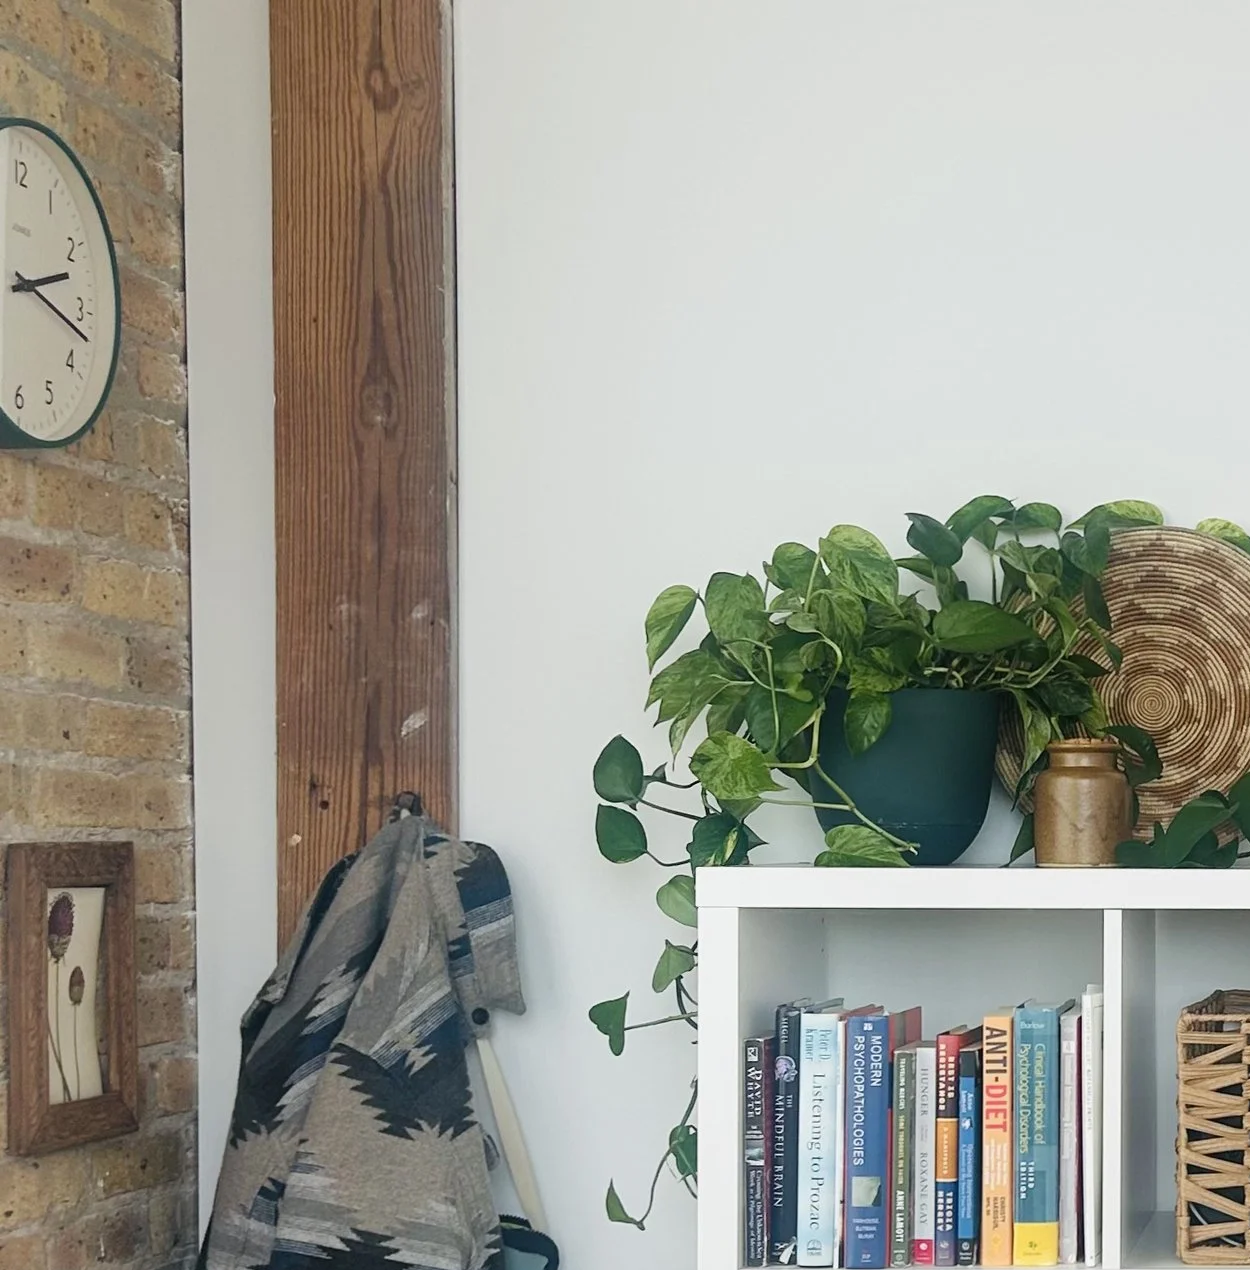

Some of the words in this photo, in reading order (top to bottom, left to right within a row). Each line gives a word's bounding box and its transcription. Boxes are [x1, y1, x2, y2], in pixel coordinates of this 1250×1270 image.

[14, 158, 28, 189] 12
[67, 237, 76, 263] 2
[76, 297, 86, 323] 3
[65, 349, 75, 374] 4
[14, 385, 25, 411] 6
[45, 381, 54, 405] 5
[805, 1029, 816, 1060] Kramer
[818, 1030, 832, 1051] Peter
[870, 1036, 882, 1086] MODERN
[985, 1026, 1007, 1132] ANTI-DIET
[1017, 1044, 1030, 1107] Psychological
[1034, 1044, 1046, 1077] Clinical
[747, 1067, 755, 1118] WHYTE
[754, 1070, 762, 1115] DAVID
[853, 1035, 865, 1165] PSYCHOPATHOLOGIES
[920, 1068, 929, 1116] HUNGER
[1034, 1080, 1046, 1132] Handbook
[774, 1095, 785, 1158] MINDFUL
[808, 1074, 825, 1150] Listening
[1019, 1109, 1029, 1153] Disorders
[1034, 1134, 1046, 1144] of
[811, 1156, 824, 1172] to
[919, 1152, 928, 1200] ROXANE
[1019, 1162, 1027, 1199] EDITION
[773, 1165, 783, 1207] BRAIN
[810, 1177, 825, 1230] Prozac
[896, 1190, 904, 1211] ANNE
[895, 1213, 904, 1242] LAMOTT
[919, 1203, 928, 1225] GAY
